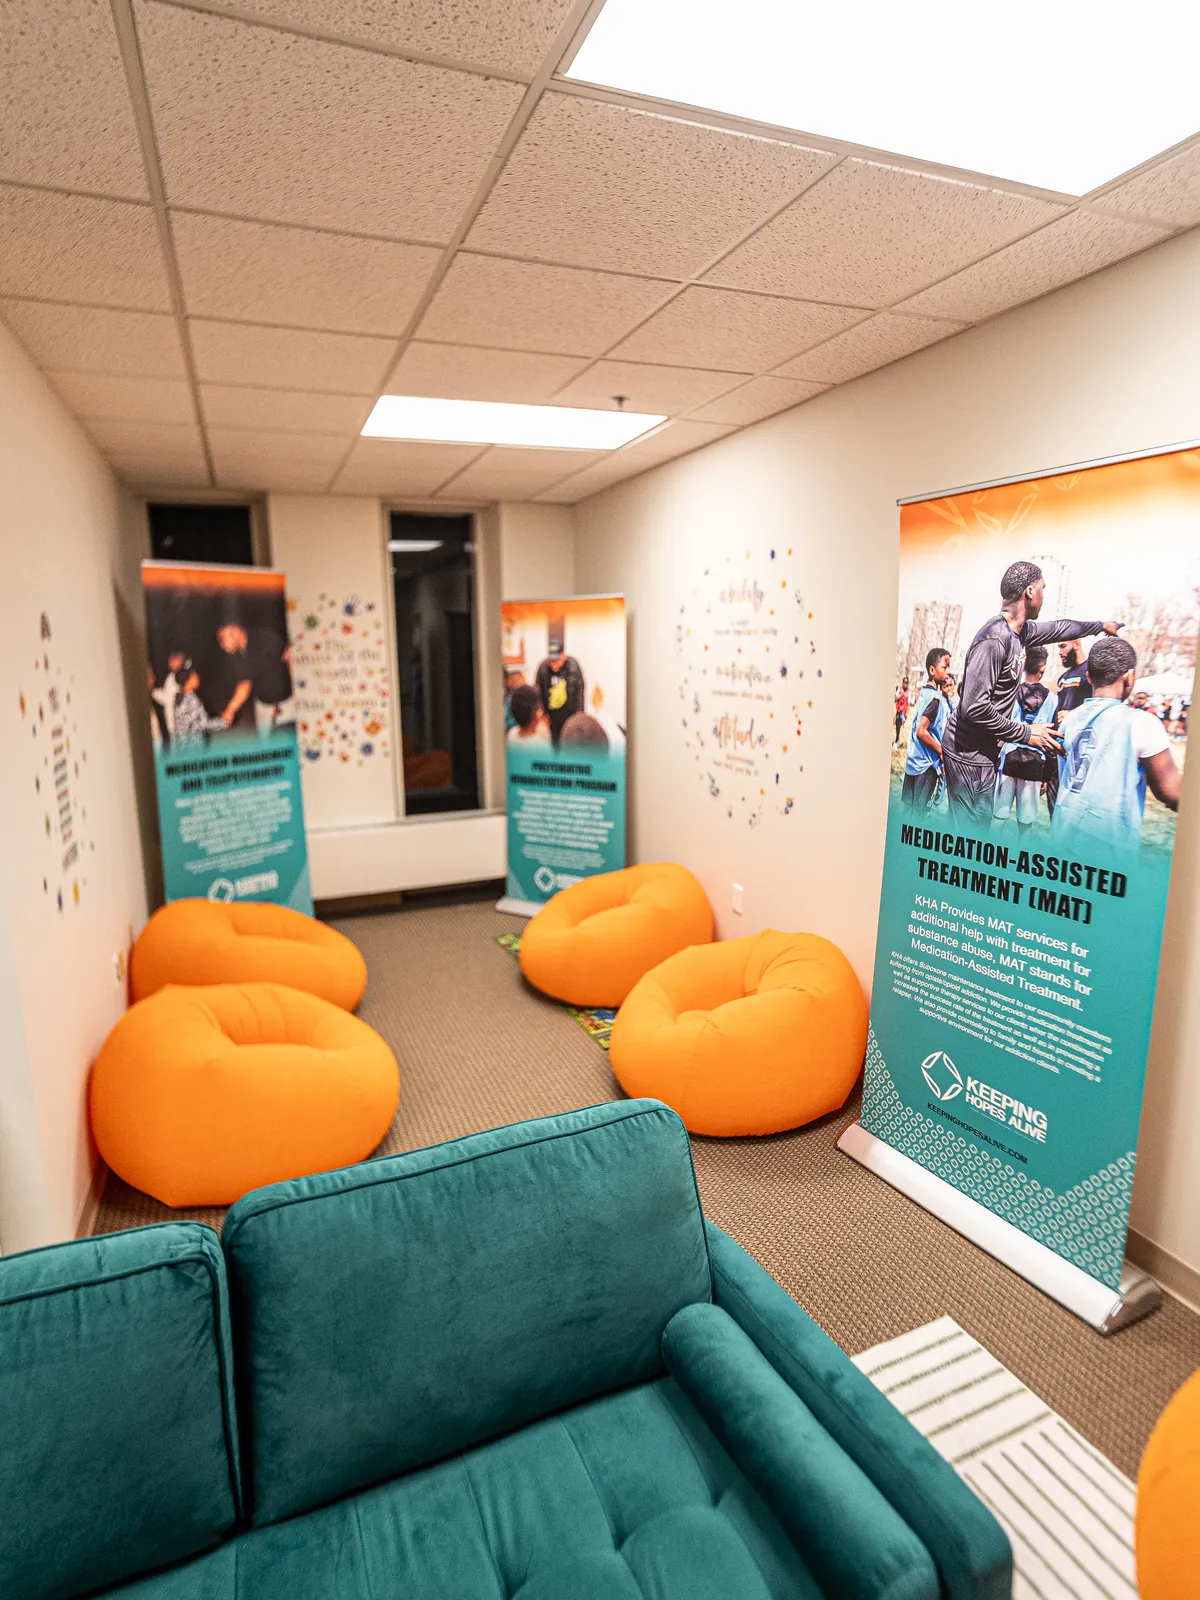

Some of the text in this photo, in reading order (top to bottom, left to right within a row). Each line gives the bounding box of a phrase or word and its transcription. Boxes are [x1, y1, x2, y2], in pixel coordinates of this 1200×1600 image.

[901, 823, 1128, 898] MEDICATION-ASSISTED
[917, 857, 1093, 925] TREATMENT (MAT)
[910, 909, 1092, 977] additional help with treatment for
[915, 894, 1090, 958] KHA Provides MAT services for
[891, 951, 903, 960] KHA
[903, 956, 918, 966] offers
[919, 961, 947, 976] Suboxone
[948, 973, 984, 992] maintenance
[985, 988, 1016, 1004] treatment
[1037, 1009, 1076, 1028] community
[908, 924, 1092, 996] substance abuse, MAT stands for
[911, 938, 1084, 1012] Medication-Assisted Treatment.
[890, 960, 911, 973] suffering
[912, 968, 924, 977] from
[990, 999, 1000, 1008] We
[1001, 1005, 1026, 1019] provide
[1027, 1015, 1066, 1034] medication
[894, 978, 919, 992] increases
[929, 994, 952, 1007] success
[953, 1004, 964, 1012] rate
[972, 1011, 981, 1019] the
[982, 1016, 1012, 1033] treatment
[1023, 1033, 1038, 1043] well
[911, 977, 940, 992] supportive
[940, 988, 961, 1002] therapy
[962, 998, 986, 1012] services
[1006, 1017, 1028, 1029] clients
[1047, 1032, 1059, 1042] the
[914, 994, 923, 1003] We
[924, 1000, 936, 1008] also
[936, 1006, 957, 1018] provide
[958, 1015, 989, 1034] counseling
[997, 1032, 1017, 1046] family
[1017, 1041, 1032, 1051] and
[919, 1007, 947, 1023] supportive
[948, 1020, 983, 1039] environment
[984, 1035, 993, 1044] for
[993, 1041, 1004, 1049] our
[1005, 1046, 1036, 1063] addiction
[927, 1102, 1029, 1165] KEEPINGHOPESALIVE.COM
[966, 1076, 1048, 1130] KEEPING
[966, 1092, 1047, 1144] HOPES ALIVE
